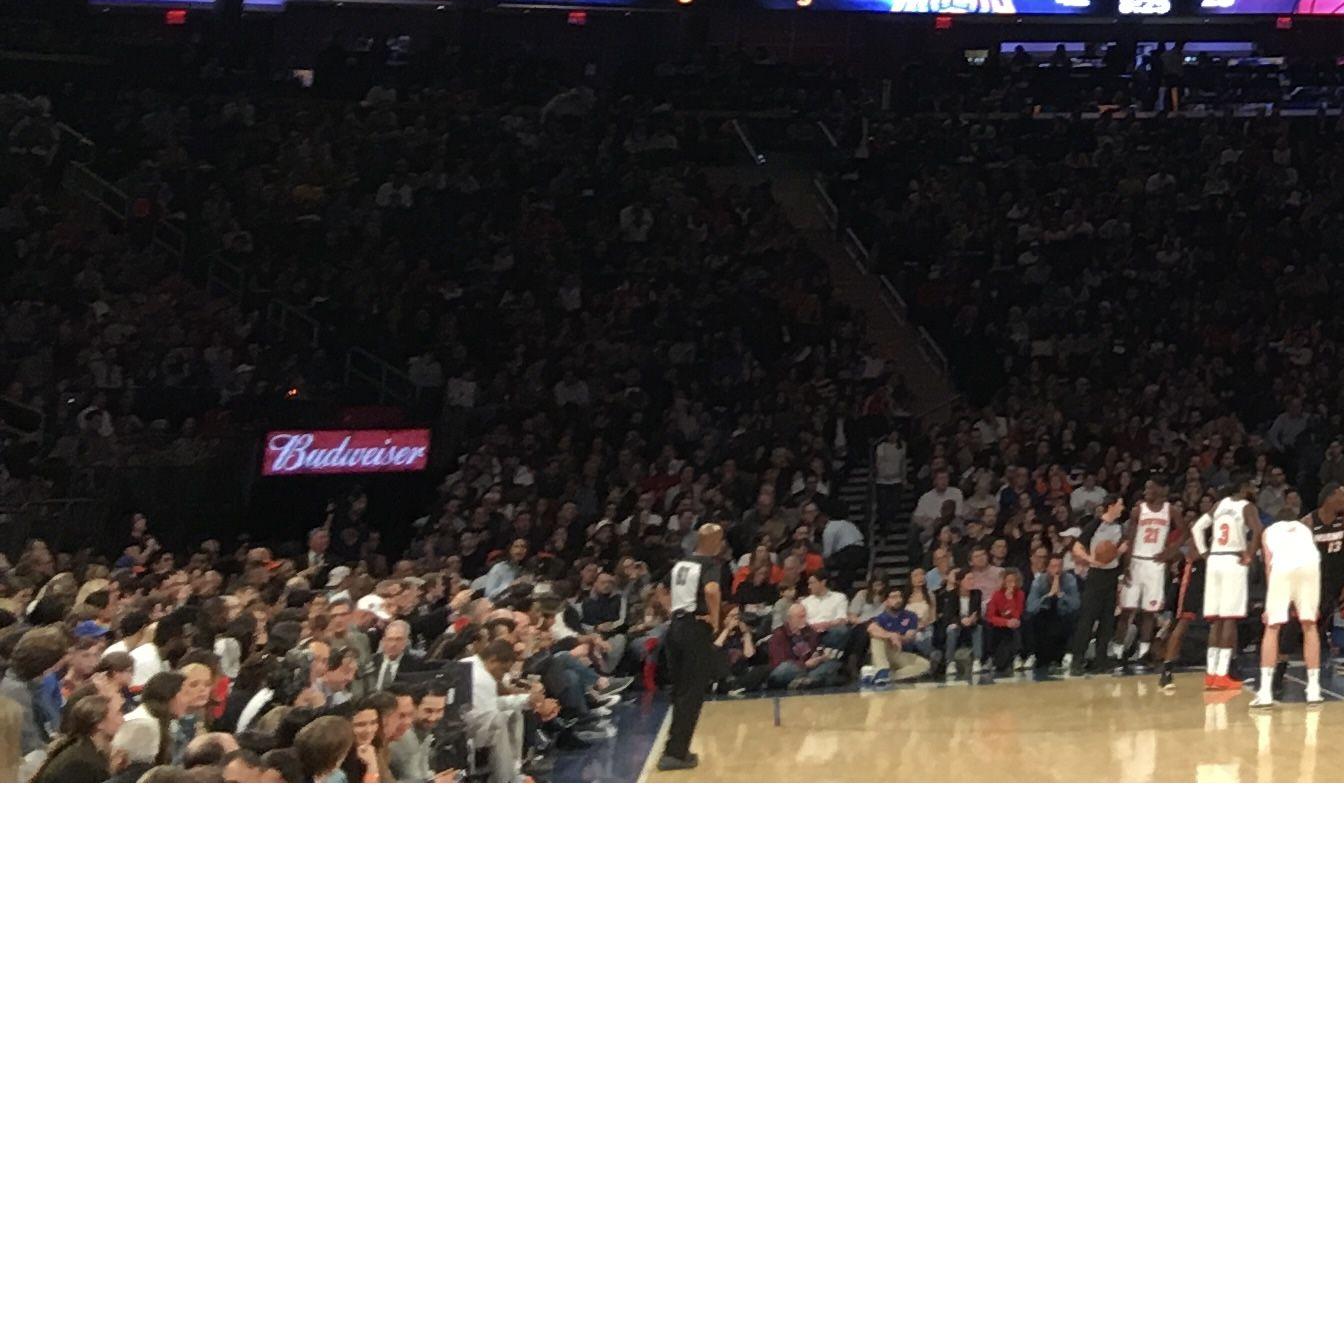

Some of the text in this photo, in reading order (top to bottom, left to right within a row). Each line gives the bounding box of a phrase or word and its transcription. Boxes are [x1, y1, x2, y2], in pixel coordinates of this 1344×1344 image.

[269, 433, 427, 471] Budweiser
[1143, 527, 1160, 543] 21
[1218, 523, 1230, 545] 3
[1328, 541, 1343, 553] 13
